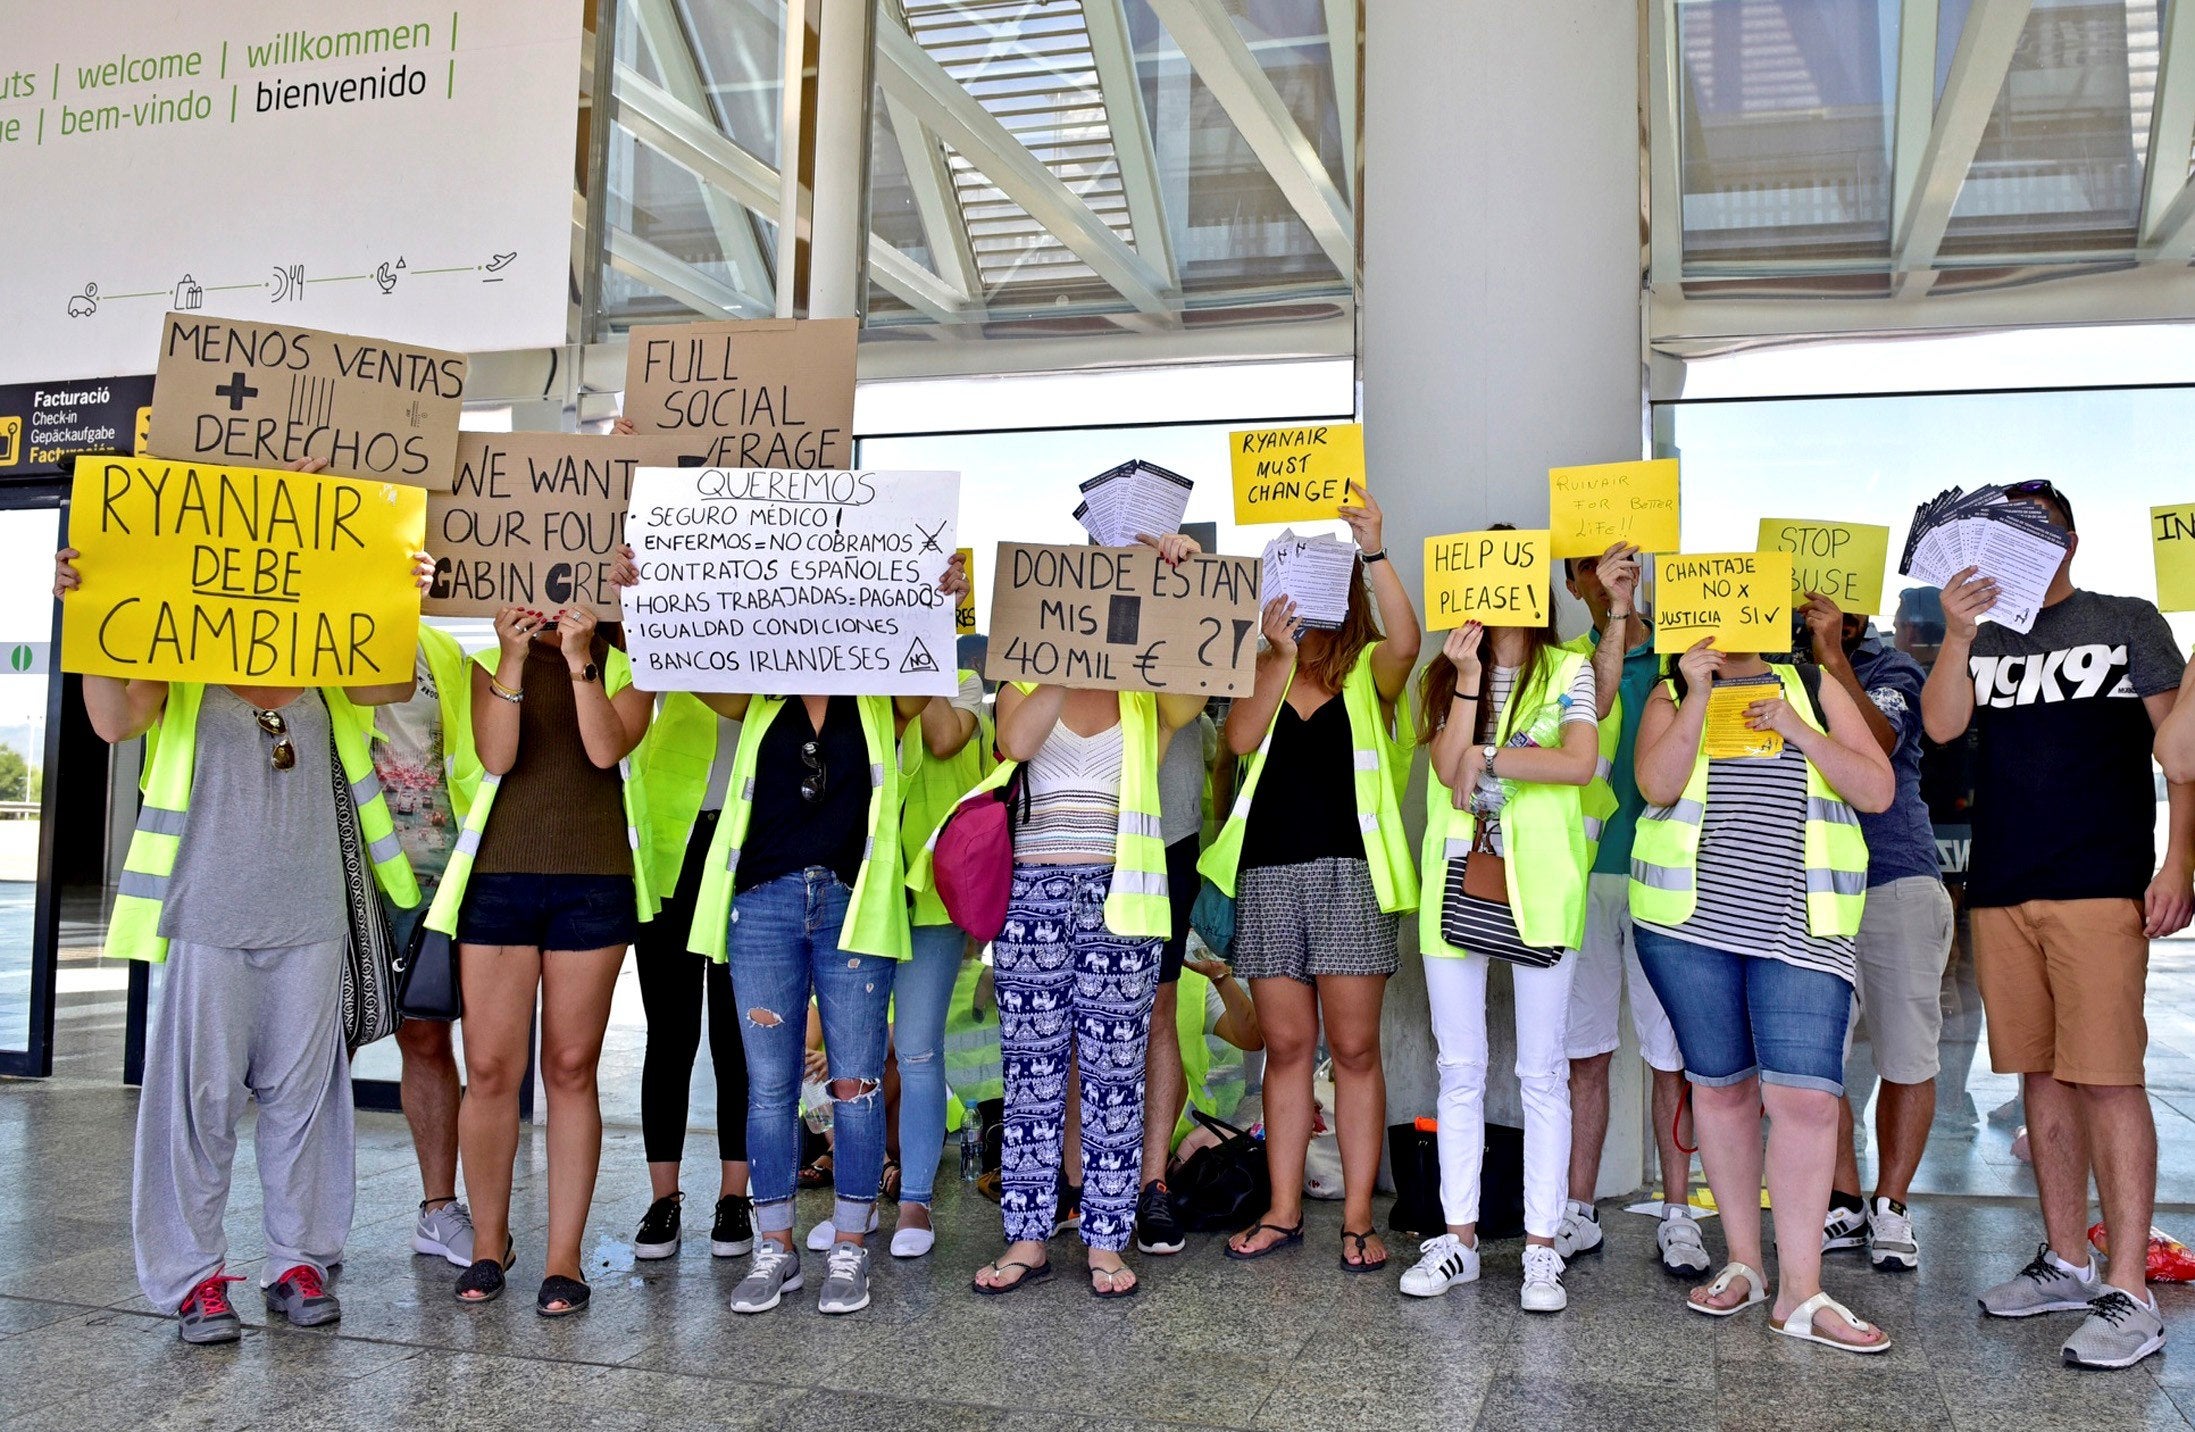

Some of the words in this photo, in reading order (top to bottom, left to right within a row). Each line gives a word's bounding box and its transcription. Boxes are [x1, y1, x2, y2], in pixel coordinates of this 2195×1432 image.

[76, 48, 203, 91] welcome
[246, 19, 431, 69] willkommen
[61, 88, 213, 136] bem-vindo
[255, 65, 427, 113] bienvenido
[168, 321, 310, 371] MENOS
[331, 343, 463, 399] VENTAS
[644, 336, 738, 384] FULL
[33, 386, 111, 408] Facturació
[656, 385, 806, 429] SOCIAL
[32, 409, 78, 426] Check-in
[30, 425, 116, 445] Gepäckaufgabe
[193, 411, 429, 475] DERECHOS
[1242, 426, 1328, 454] RYANAIR
[451, 444, 511, 499] WE
[526, 455, 641, 502] WANT
[1256, 453, 1312, 479] MUST
[696, 468, 878, 506] QUEREMOS
[101, 462, 365, 553] RYANAIR
[647, 505, 738, 527] SEGURO
[443, 508, 531, 548] OUR
[644, 532, 752, 551] ENFERMOS
[805, 534, 914, 554] COBRAMOS
[1778, 526, 1851, 559] STOP
[191, 544, 301, 598] DEBE
[640, 559, 778, 582] CONTRATOS
[791, 555, 920, 584] ESPAÑOLES
[1435, 539, 1494, 572] HELP
[1503, 541, 1534, 568] US
[1665, 557, 1756, 587] CHANTAJE
[1013, 548, 1136, 592] DONDE
[1151, 553, 1259, 606] ESTAN
[1703, 579, 1731, 600] NO
[636, 591, 710, 615] HORAS
[716, 585, 848, 612] TRABAJADAS
[1440, 584, 1541, 620] PLEASE!
[640, 618, 744, 639] IGUALDAD
[752, 617, 899, 636] CONDICIONES
[1040, 599, 1098, 636] MIS
[1658, 610, 1722, 630] JUSTICIA
[1739, 606, 1759, 625] SI
[95, 595, 381, 679] CAMBIAR
[649, 650, 740, 671] BANCOS
[749, 645, 890, 673] IRLANDESES
